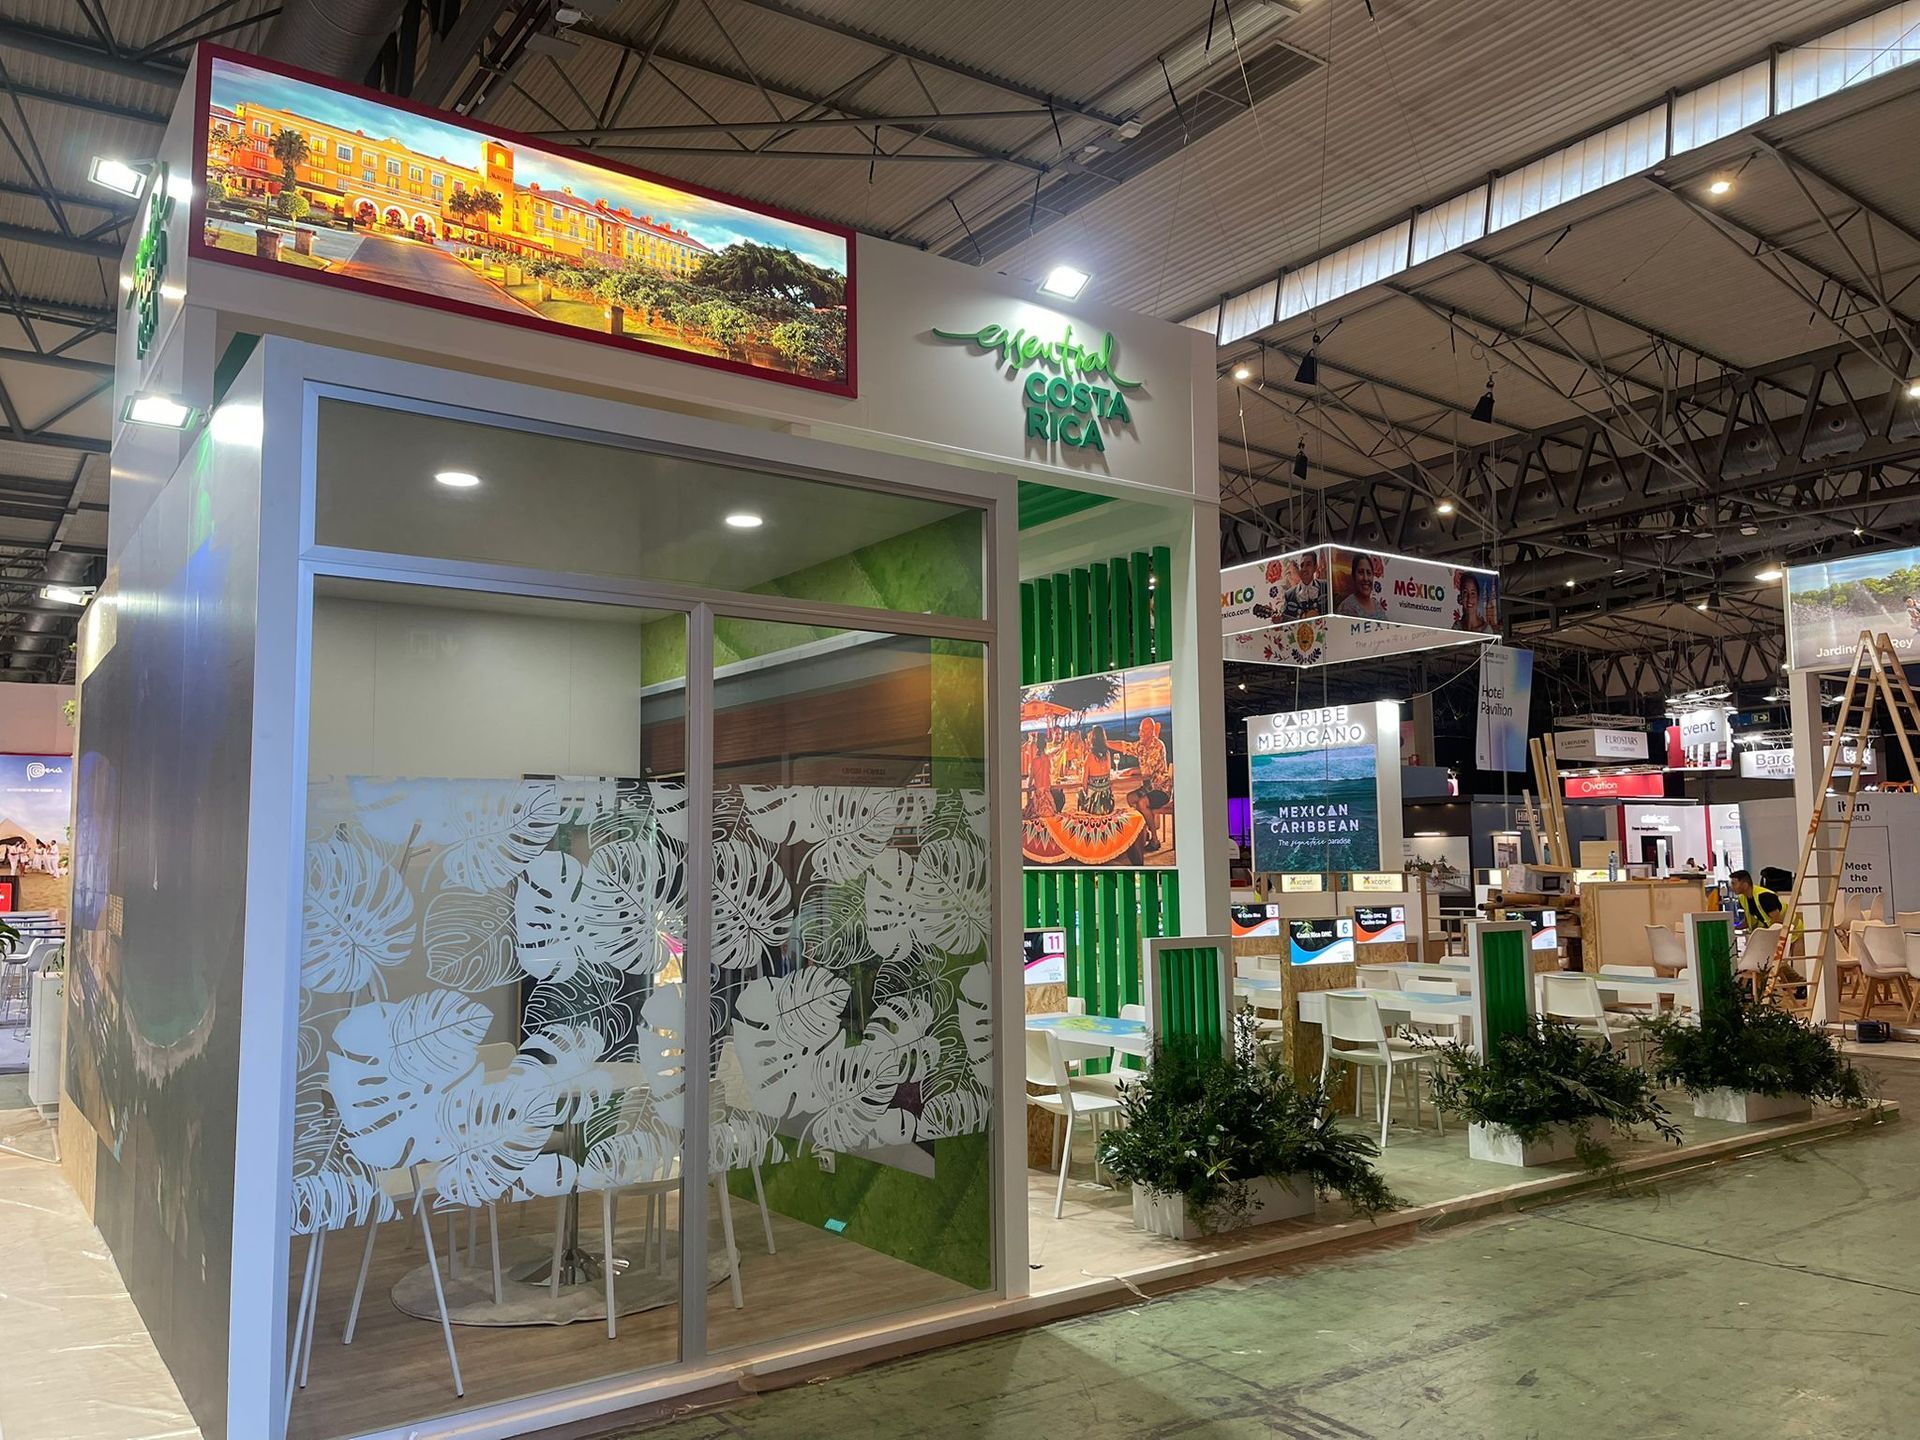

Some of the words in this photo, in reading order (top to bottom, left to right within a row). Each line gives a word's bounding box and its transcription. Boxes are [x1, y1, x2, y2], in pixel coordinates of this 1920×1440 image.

[932, 323, 1143, 388] essential
[1025, 372, 1131, 424] COSTA
[1026, 406, 1105, 452] RICA
[1221, 586, 1254, 607] XICO
[1222, 608, 1250, 618] xico.com
[1399, 600, 1443, 613] visitmexico.com
[1892, 638, 1914, 650] Rey
[1481, 685, 1505, 700] Hotel
[1480, 701, 1513, 718] Pavilion
[1272, 707, 1347, 728] CARIBE
[1682, 719, 1716, 736] cvent
[1258, 726, 1363, 749] MEXICANO
[1604, 735, 1638, 746] EUROSTARS
[1755, 753, 1791, 767] Barc
[1581, 781, 1618, 793] Ovation
[1279, 803, 1349, 818] MEXICAN
[1270, 818, 1360, 835] CARIBBEAN
[1278, 838, 1290, 847] The
[1327, 837, 1352, 847] paradise
[1845, 862, 1872, 871] Meet
[1849, 874, 1868, 882] the
[1837, 886, 1883, 894] moment
[1394, 908, 1402, 920] 2
[1341, 922, 1349, 935] 6
[1048, 935, 1061, 950] 11
